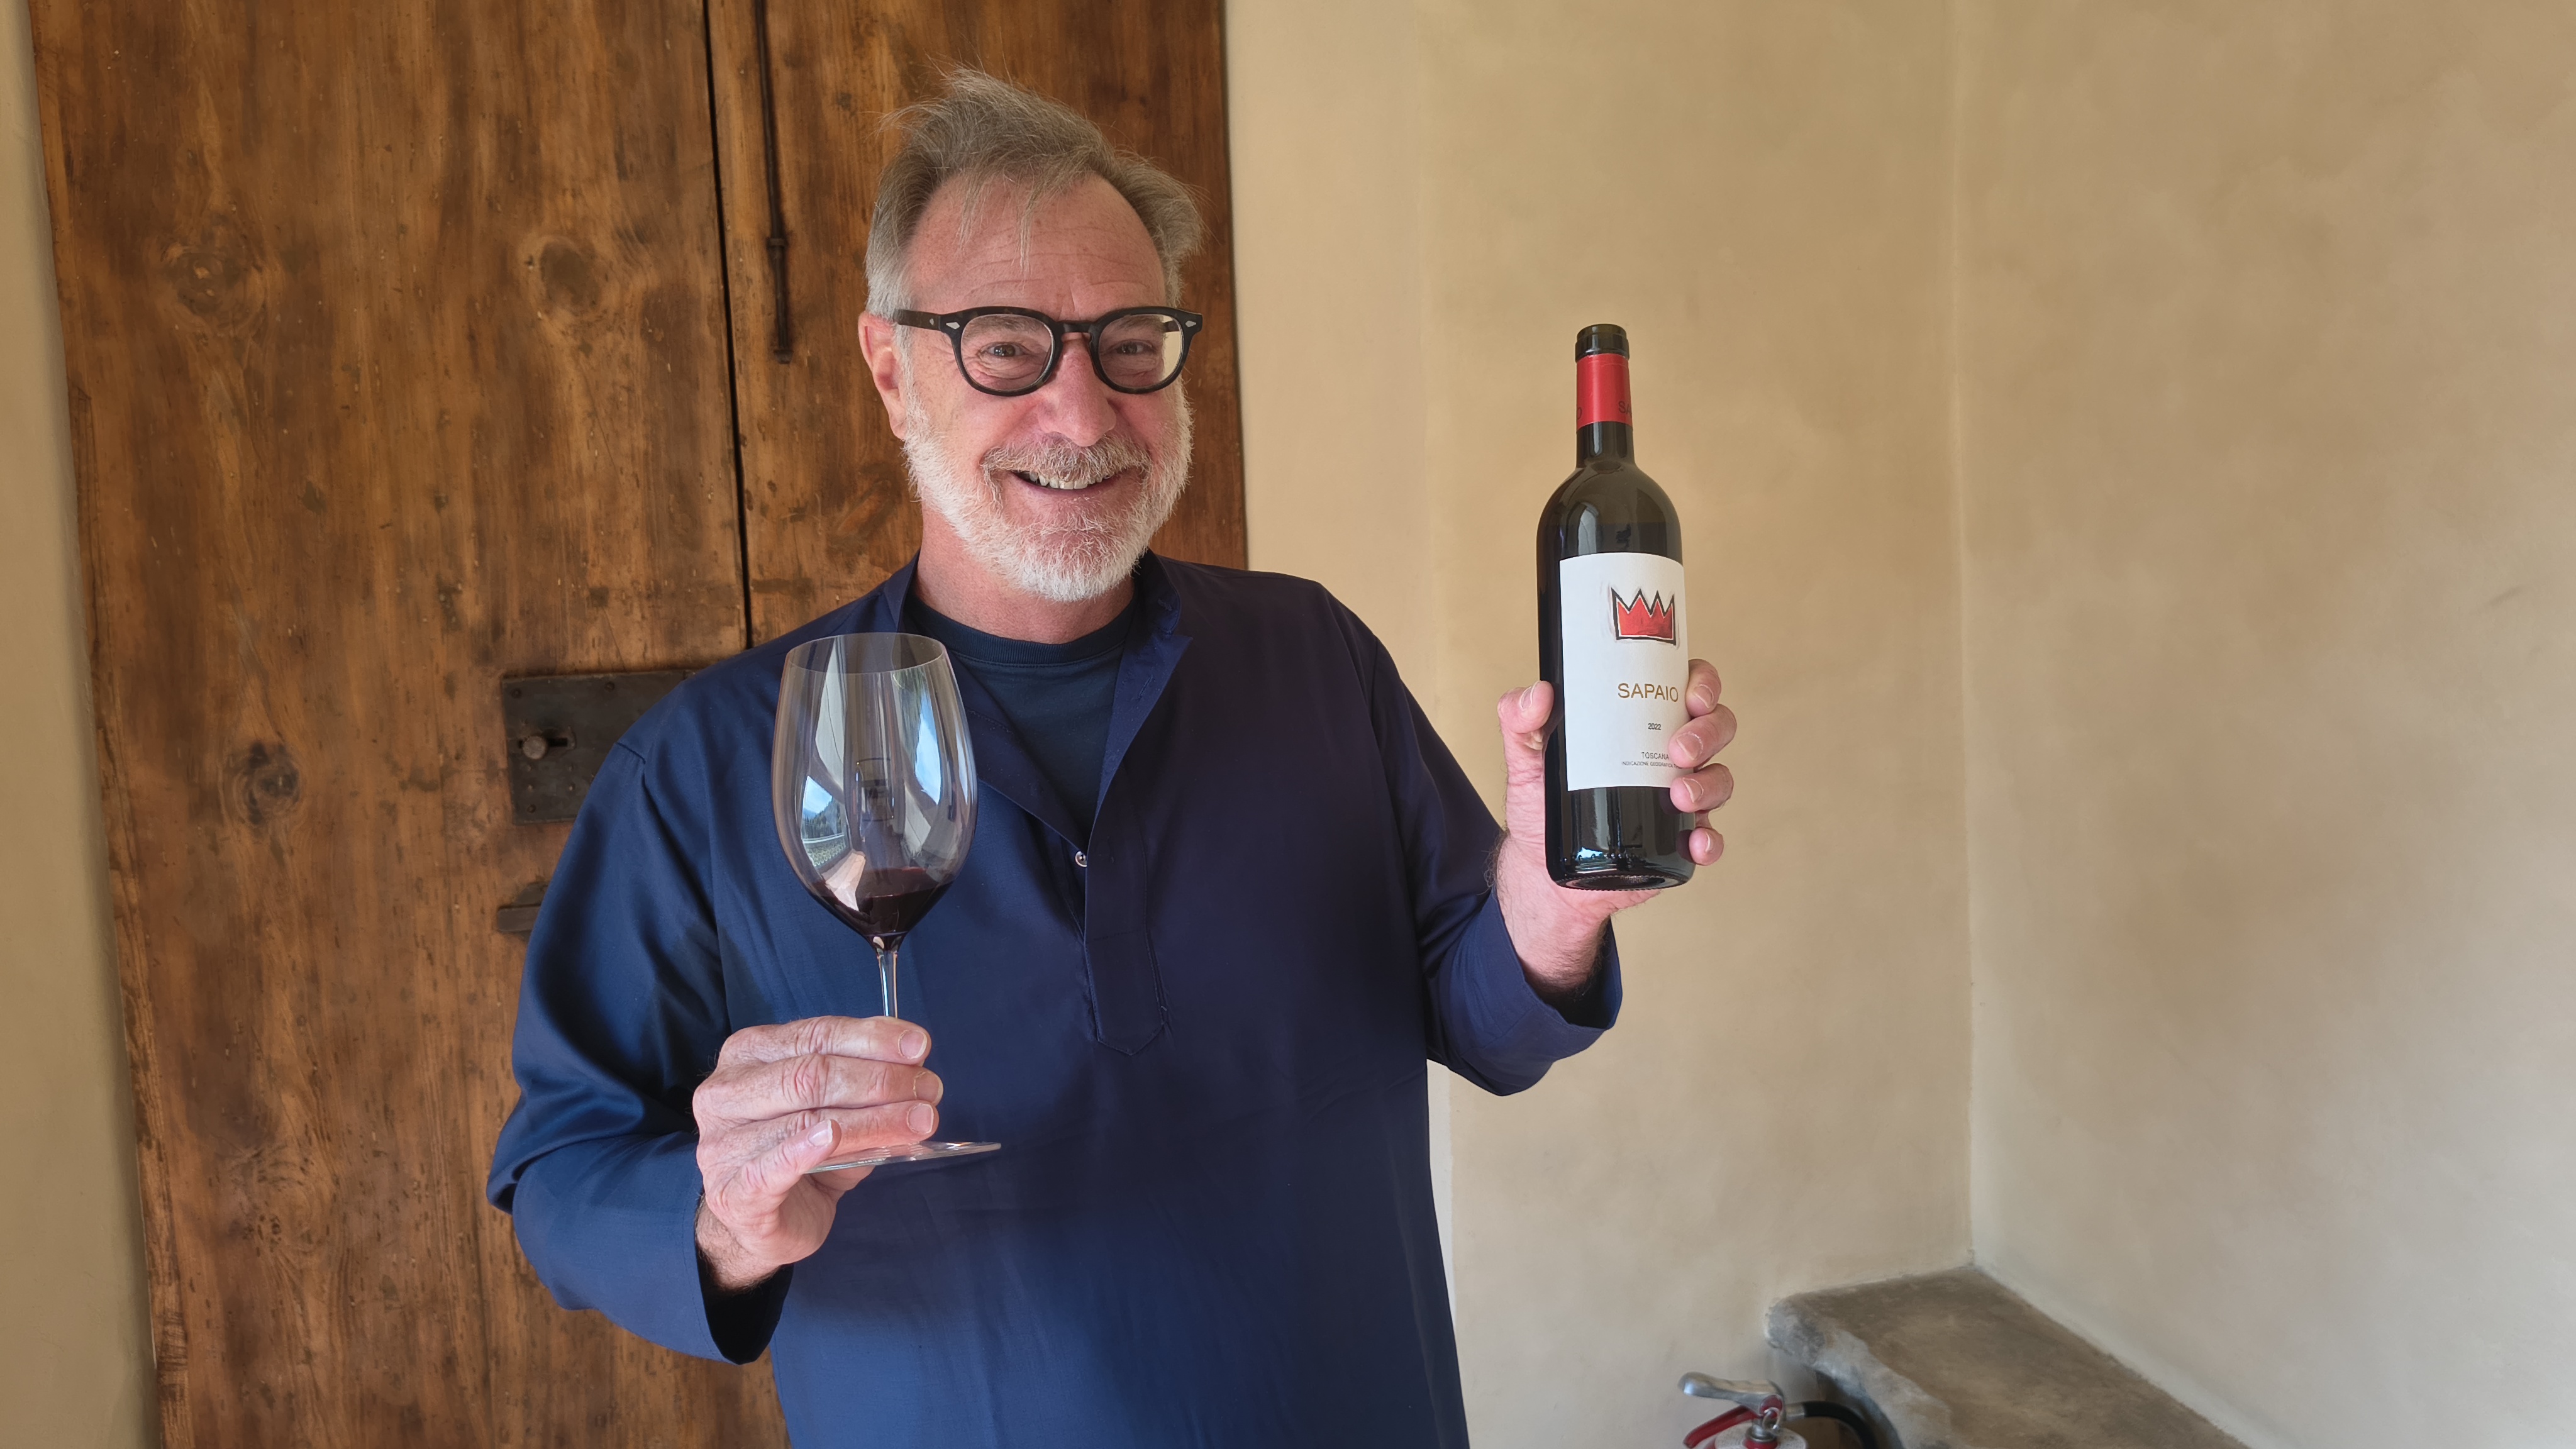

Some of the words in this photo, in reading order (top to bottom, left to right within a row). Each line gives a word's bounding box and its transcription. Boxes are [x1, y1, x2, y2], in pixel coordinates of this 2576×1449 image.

[1618, 682, 1679, 702] SAPAIO
[1648, 723, 1662, 731] 2022
[1641, 752, 1670, 760] TOSCANA
